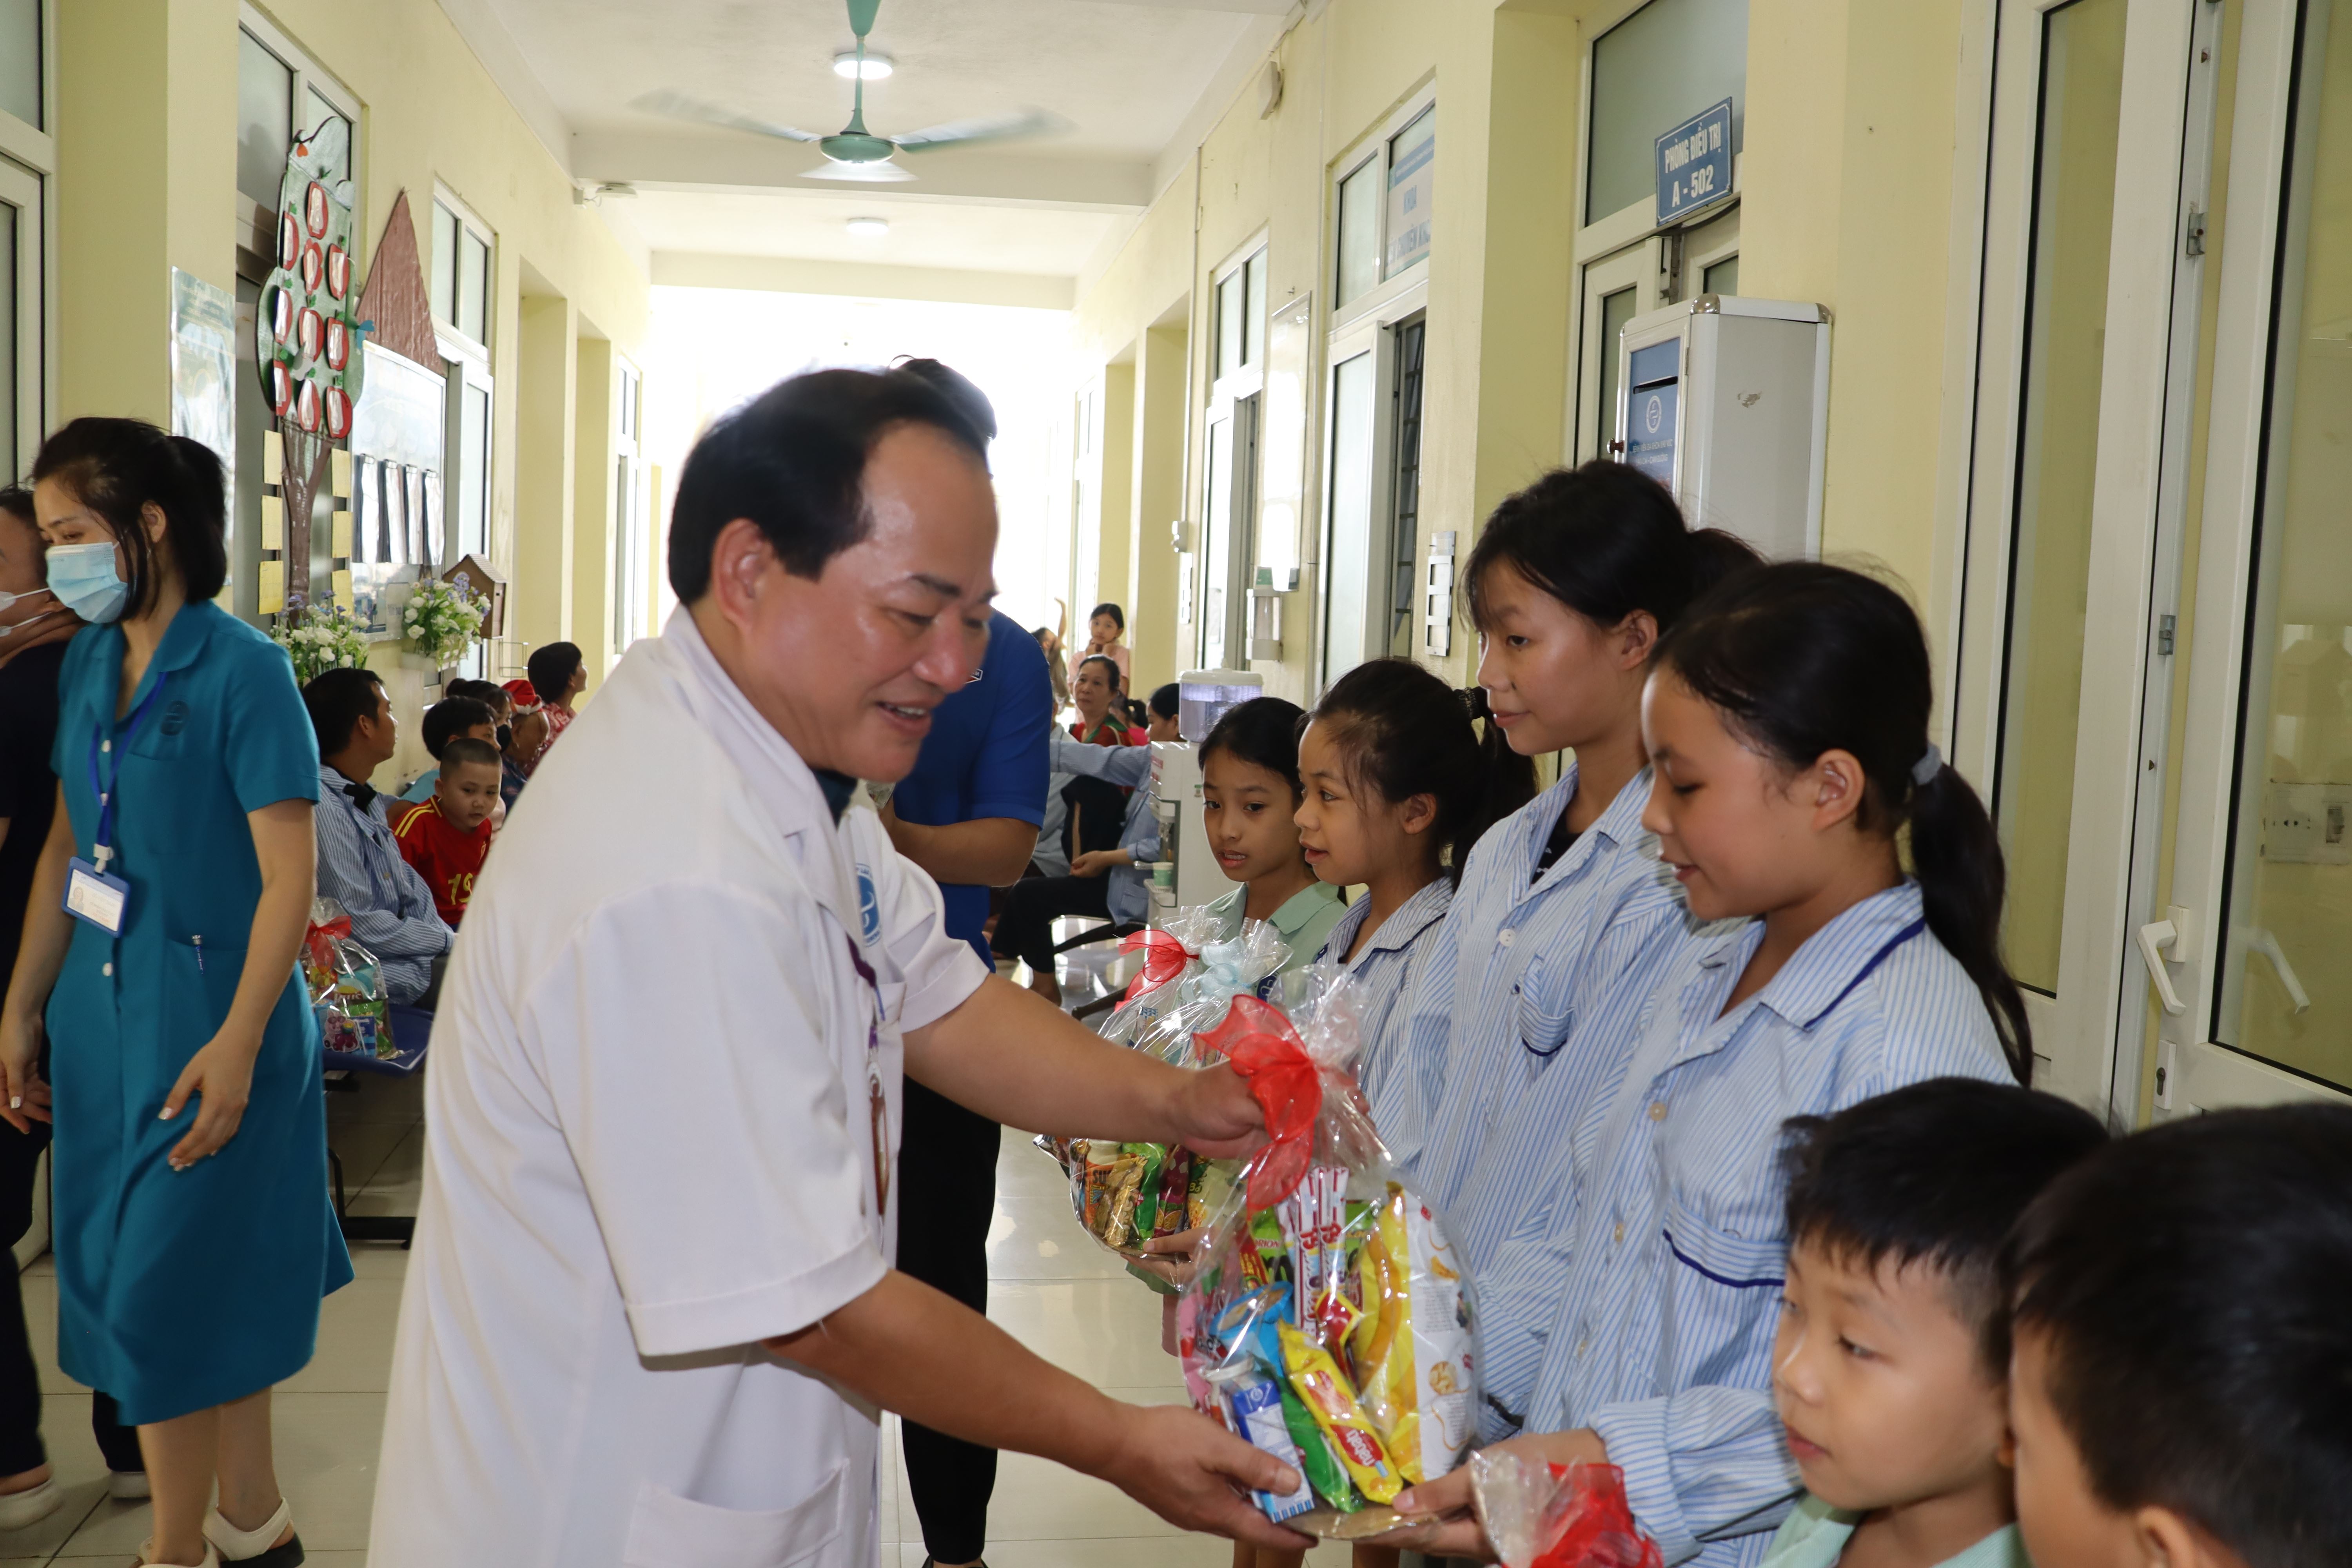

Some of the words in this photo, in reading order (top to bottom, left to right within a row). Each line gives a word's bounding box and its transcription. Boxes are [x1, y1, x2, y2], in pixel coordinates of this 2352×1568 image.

[1664, 138, 1689, 174] PHÒNG
[1690, 122, 1708, 161] ĐIỀU
[1709, 122, 1721, 153] TRỊ
[1671, 181, 1681, 207] A
[1691, 164, 1714, 198] 502
